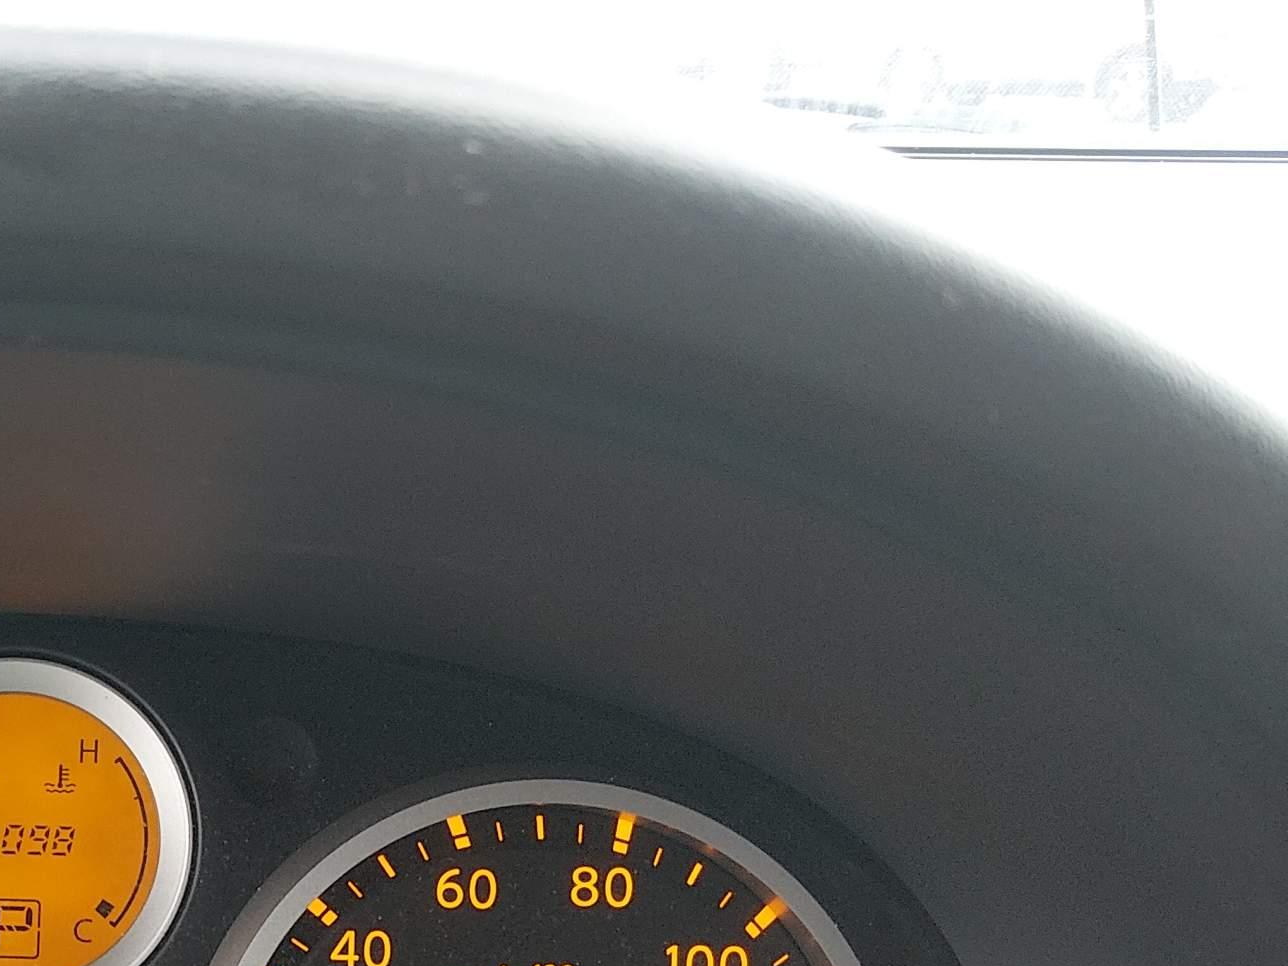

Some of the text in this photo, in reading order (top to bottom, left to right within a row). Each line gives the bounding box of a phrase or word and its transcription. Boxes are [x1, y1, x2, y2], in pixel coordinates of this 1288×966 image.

[79, 739, 99, 763] H
[435, 868, 498, 910] 60
[569, 865, 635, 908] 80
[74, 919, 93, 942] C
